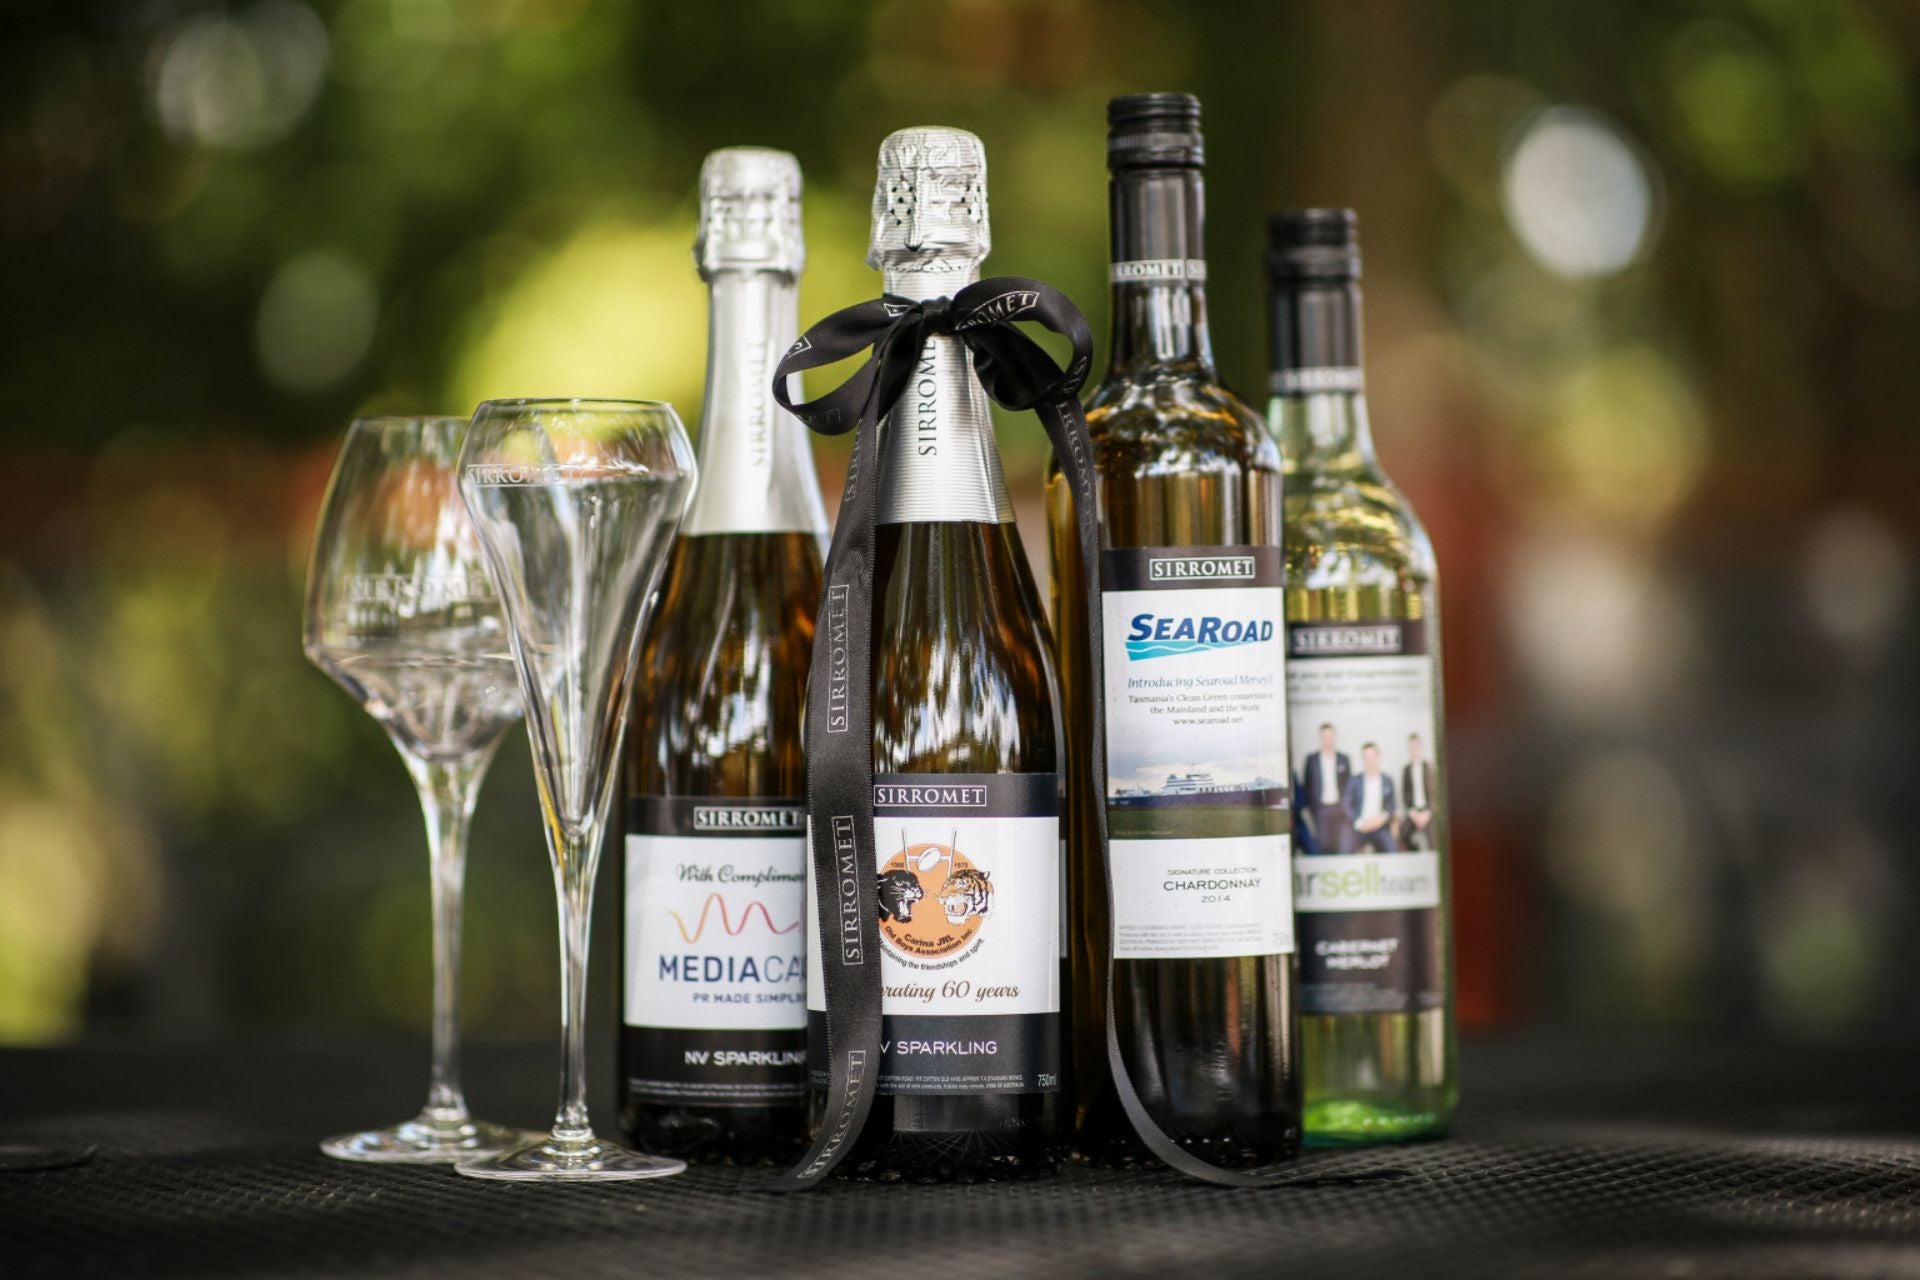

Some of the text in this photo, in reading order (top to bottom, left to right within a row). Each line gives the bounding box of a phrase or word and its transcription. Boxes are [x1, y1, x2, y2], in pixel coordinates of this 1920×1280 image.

[917, 339, 937, 456] SIRROME
[1154, 560, 1252, 576] SIRROMET
[831, 590, 846, 727] SIRROMET
[1128, 676, 1194, 690] Introducing
[1195, 675, 1238, 687] Searoad
[1176, 693, 1201, 702] Clean
[1203, 692, 1229, 702] Green
[1150, 705, 1164, 714] the
[1167, 704, 1207, 714] Mainland
[1209, 703, 1225, 713] and
[1226, 703, 1239, 712] the
[878, 788, 984, 804] SIRROMET
[697, 811, 801, 826] SIRROMET
[676, 863, 713, 883] With
[1168, 868, 1211, 876] SIGNATURE
[838, 821, 860, 959] SIRROMET
[1163, 878, 1261, 891] CHARDONNAY
[1201, 894, 1231, 904] 2014
[885, 926, 896, 939] Old
[915, 939, 961, 955] Association
[904, 933, 934, 947] Carina
[693, 993, 709, 1003] PR
[714, 993, 751, 1003] MADE
[942, 980, 971, 998] 60
[975, 985, 1020, 1003] years
[896, 1041, 998, 1055] SPARKLING
[685, 1051, 709, 1065] NV
